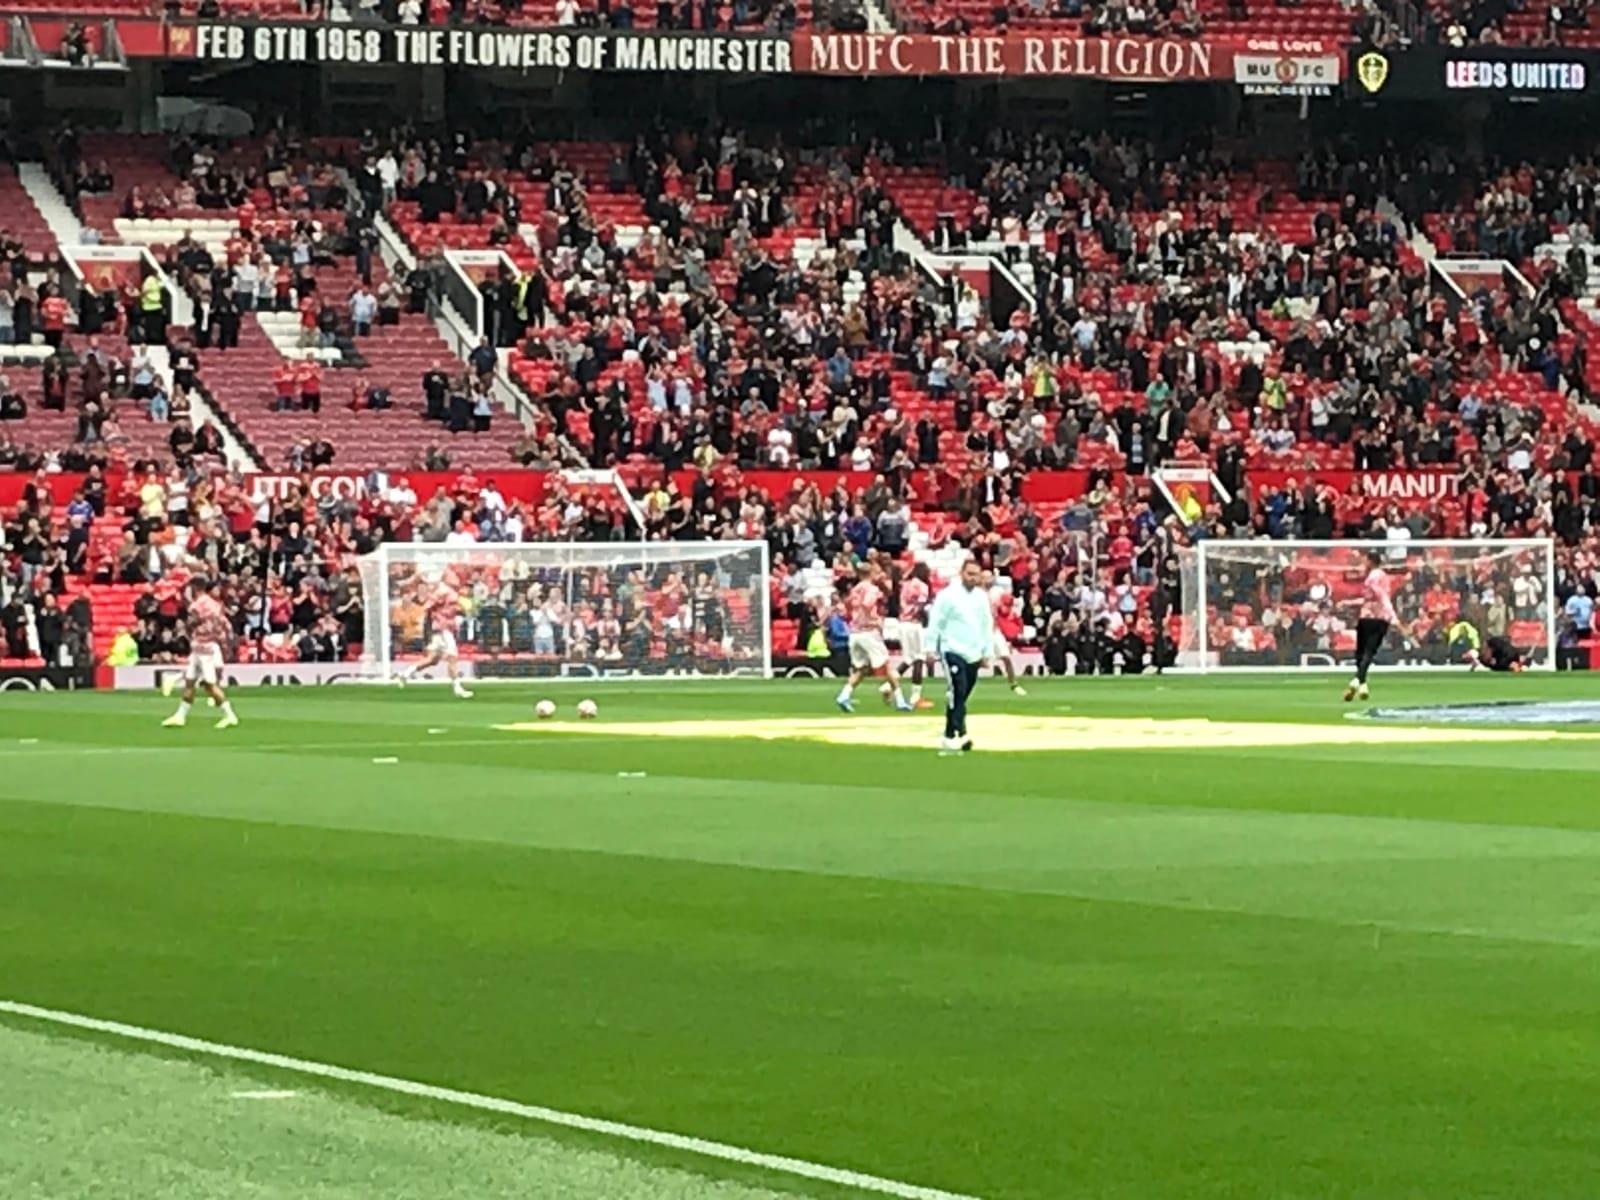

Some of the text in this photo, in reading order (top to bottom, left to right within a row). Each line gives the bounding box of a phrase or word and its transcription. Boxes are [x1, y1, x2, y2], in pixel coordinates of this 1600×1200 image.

[197, 25, 792, 72] FEB 6TH 1958 THE FLOWERS OF MANCHESTER
[810, 35, 1212, 78] MUFC THE RELIGION
[1282, 40, 1323, 52] LOVE
[1446, 60, 1585, 89] LEEDS UNITED
[1243, 84, 1332, 96] MANCHESTER
